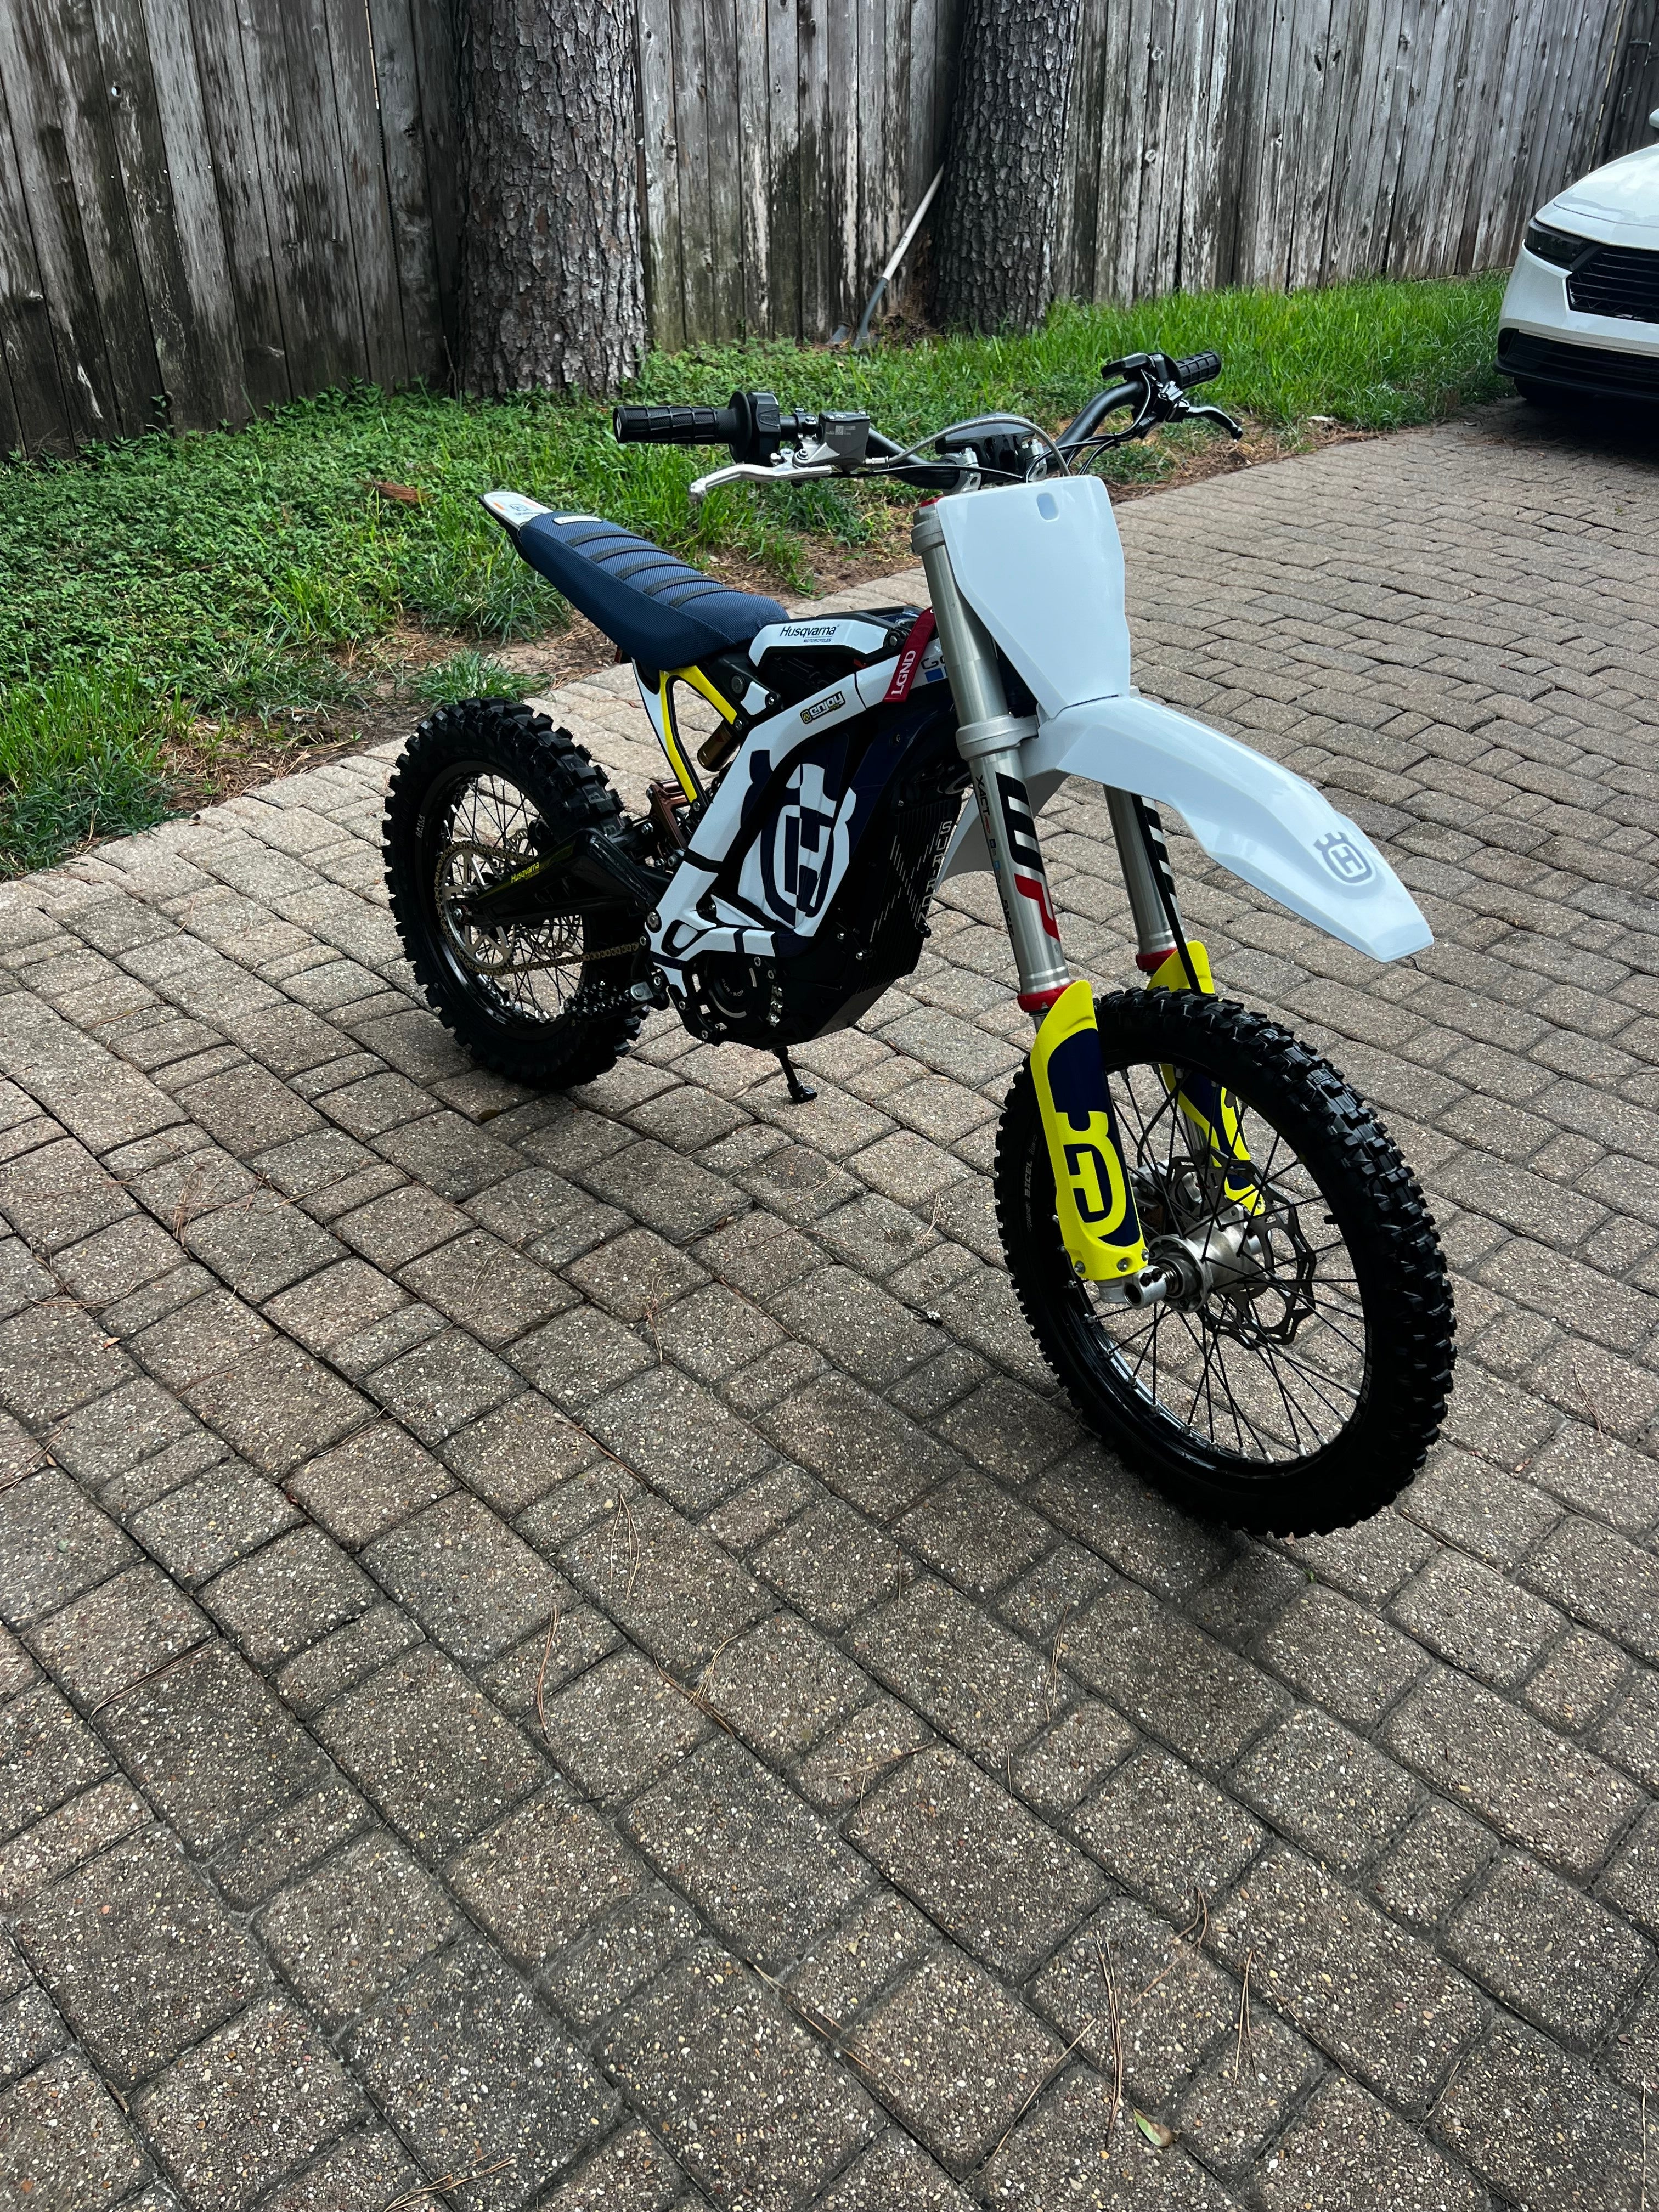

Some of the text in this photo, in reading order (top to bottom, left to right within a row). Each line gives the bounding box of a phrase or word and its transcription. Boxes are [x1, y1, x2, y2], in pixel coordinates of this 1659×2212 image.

[780, 625, 837, 637] Husqvarna
[891, 650, 916, 695] LGND
[809, 693, 845, 719] enjoy
[975, 775, 991, 816] XACT
[511, 861, 540, 884] Husqvarna
[1024, 1160, 1033, 1198] EXCEL
